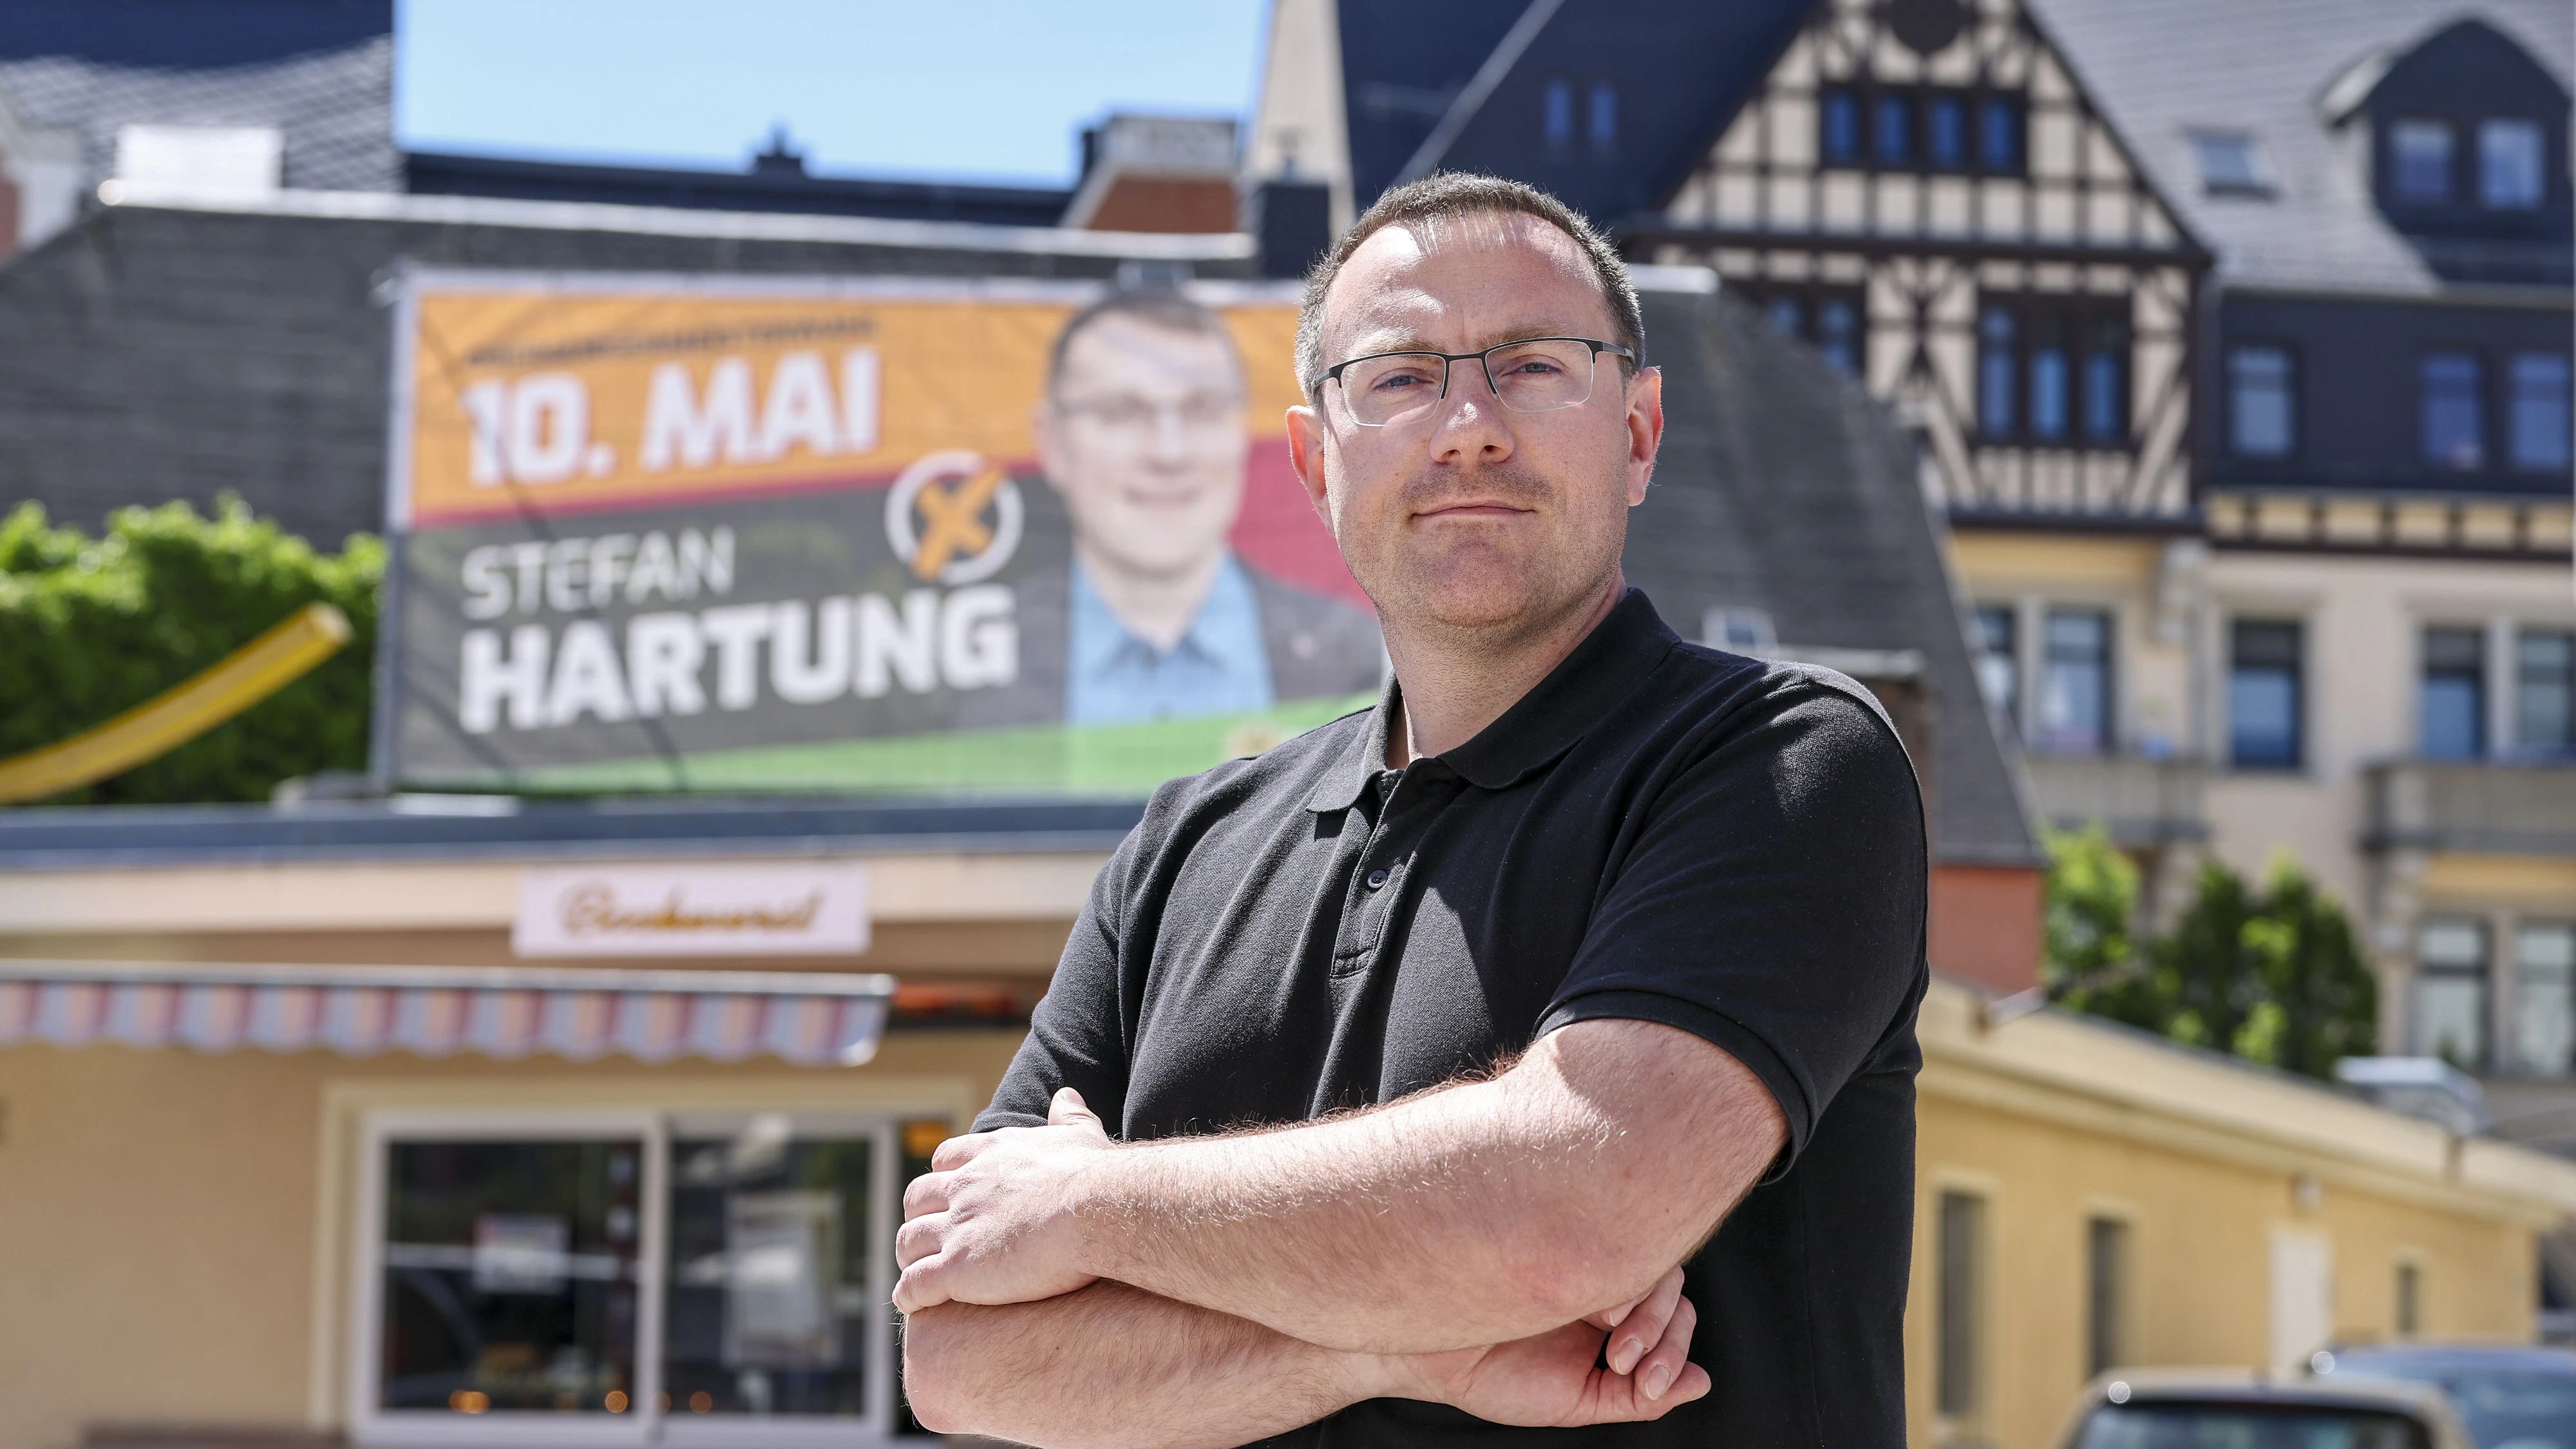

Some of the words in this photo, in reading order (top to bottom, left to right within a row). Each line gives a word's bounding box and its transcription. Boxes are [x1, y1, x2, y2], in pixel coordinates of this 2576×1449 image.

[462, 373, 616, 486] 10.
[640, 346, 880, 472] MAI
[462, 526, 735, 621] STEFAN
[460, 585, 1019, 734] HARTUNG
